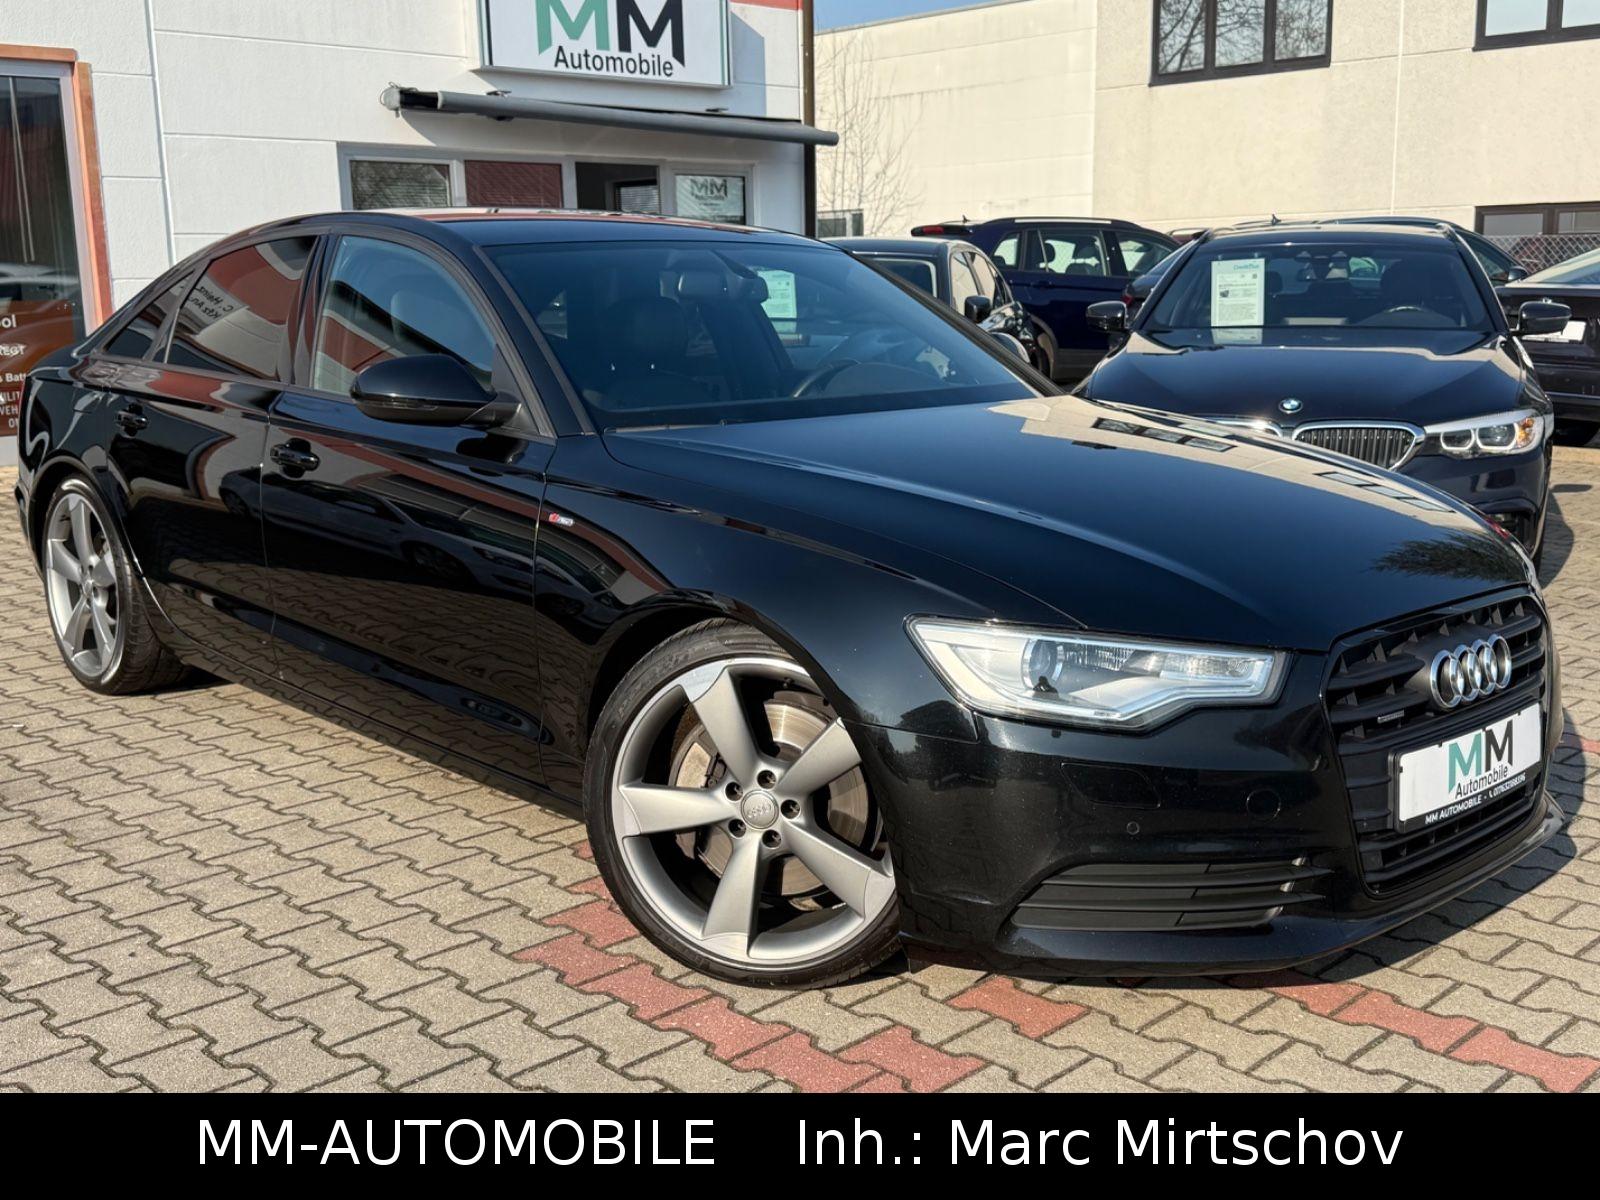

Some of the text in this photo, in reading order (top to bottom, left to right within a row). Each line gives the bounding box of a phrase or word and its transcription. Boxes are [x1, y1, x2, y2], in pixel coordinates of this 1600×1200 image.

[535, 0, 685, 68] MM
[554, 45, 674, 77] Automobile
[690, 178, 728, 198] MM
[1448, 719, 1513, 793] MM
[1455, 764, 1508, 799] Automobile
[1439, 794, 1482, 820] AUTOMOBILE
